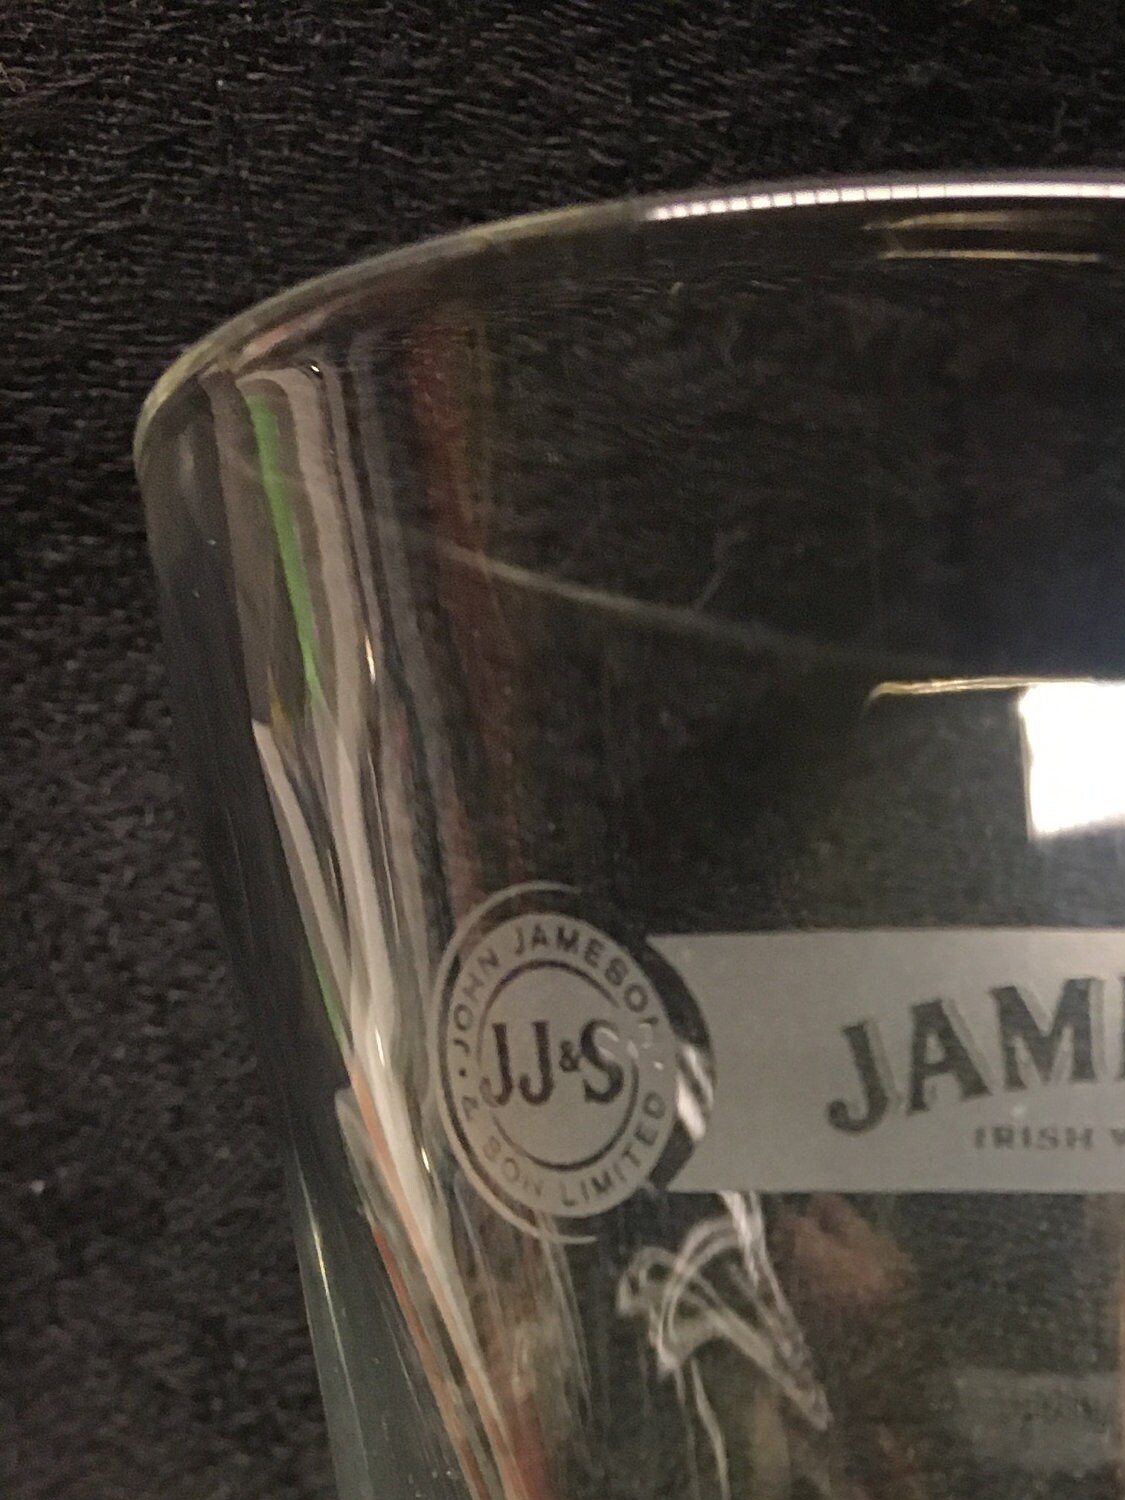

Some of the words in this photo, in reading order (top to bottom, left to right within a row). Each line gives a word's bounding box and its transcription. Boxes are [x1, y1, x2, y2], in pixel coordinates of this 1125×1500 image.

[452, 948, 500, 1058] JOHN
[479, 1019, 626, 1106] JJ&S
[560, 1090, 667, 1207] LIMITED
[973, 1125, 1094, 1150] IRISH
